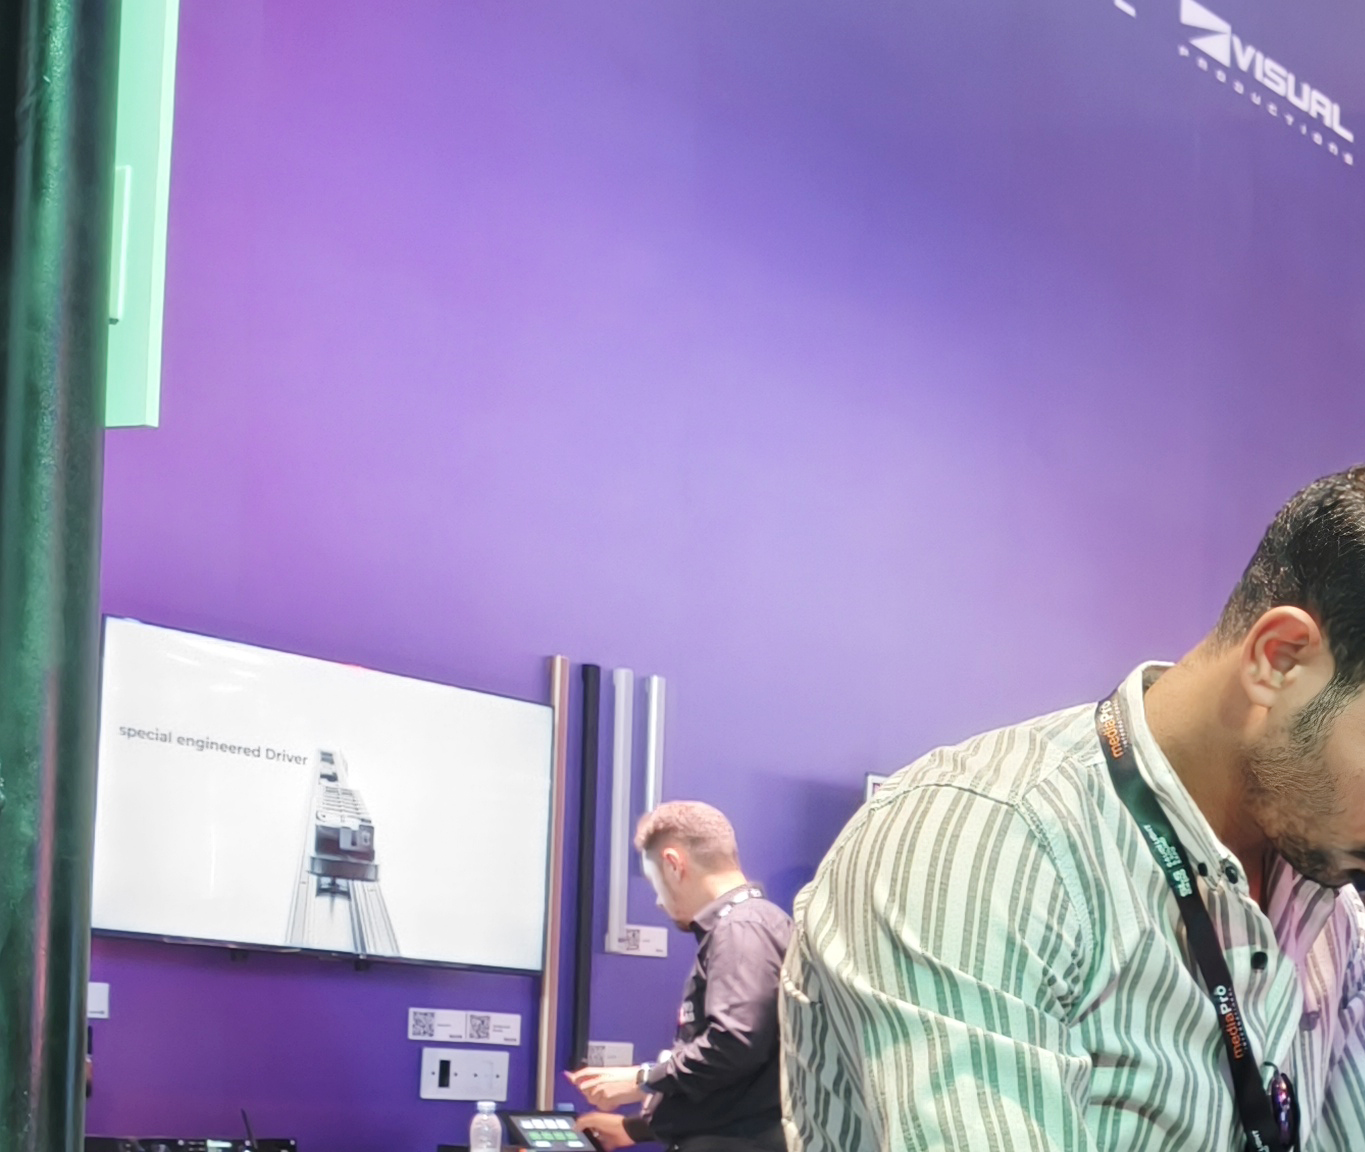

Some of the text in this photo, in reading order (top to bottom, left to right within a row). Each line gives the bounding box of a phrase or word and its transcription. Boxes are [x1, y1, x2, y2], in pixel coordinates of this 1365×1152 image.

[1178, 45, 1353, 165] PRODUCTIONS
[1232, 34, 1354, 143] VISUAL
[119, 724, 308, 765] special engineered Driver
[1099, 699, 1125, 759] mediaPro
[1213, 984, 1244, 1059] mediaPro
